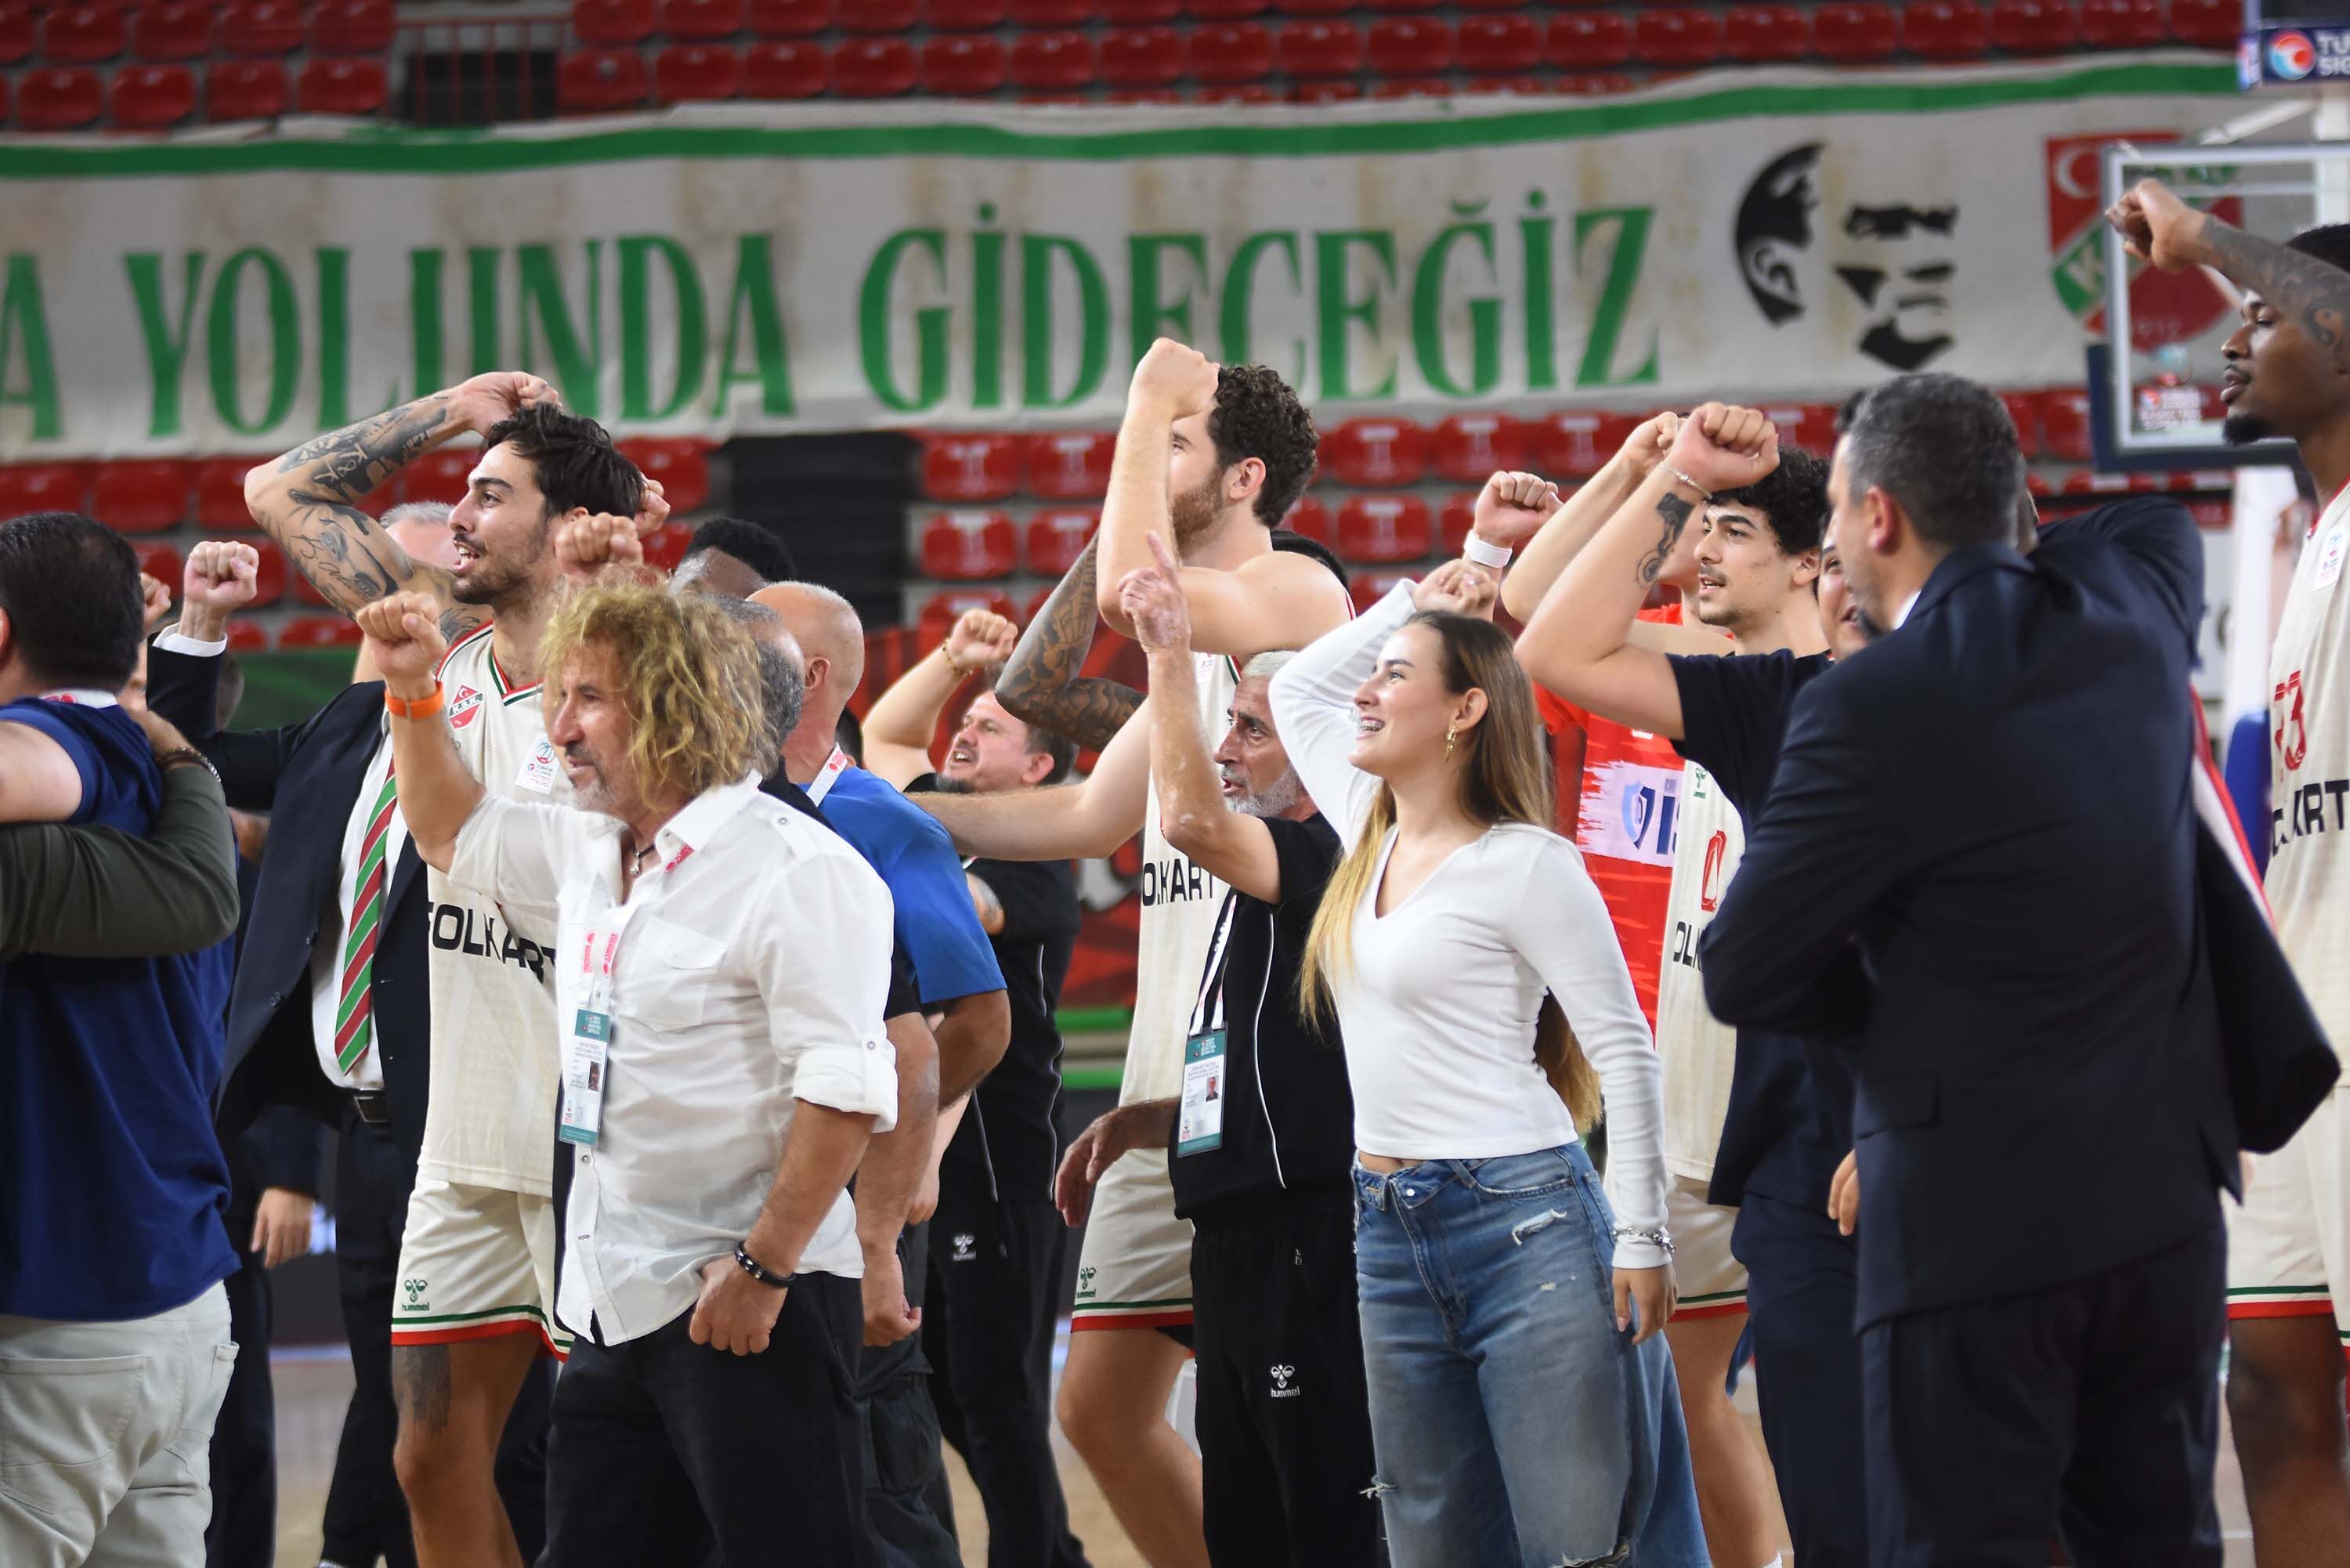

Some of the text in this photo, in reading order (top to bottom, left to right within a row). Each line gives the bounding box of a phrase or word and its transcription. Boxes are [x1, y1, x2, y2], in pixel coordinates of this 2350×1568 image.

[123, 233, 797, 439] YOLUNDA
[859, 189, 1661, 412] GİDECEĞİZ
[401, 1302, 430, 1312] hummel
[1271, 1386, 1300, 1398] hummel
